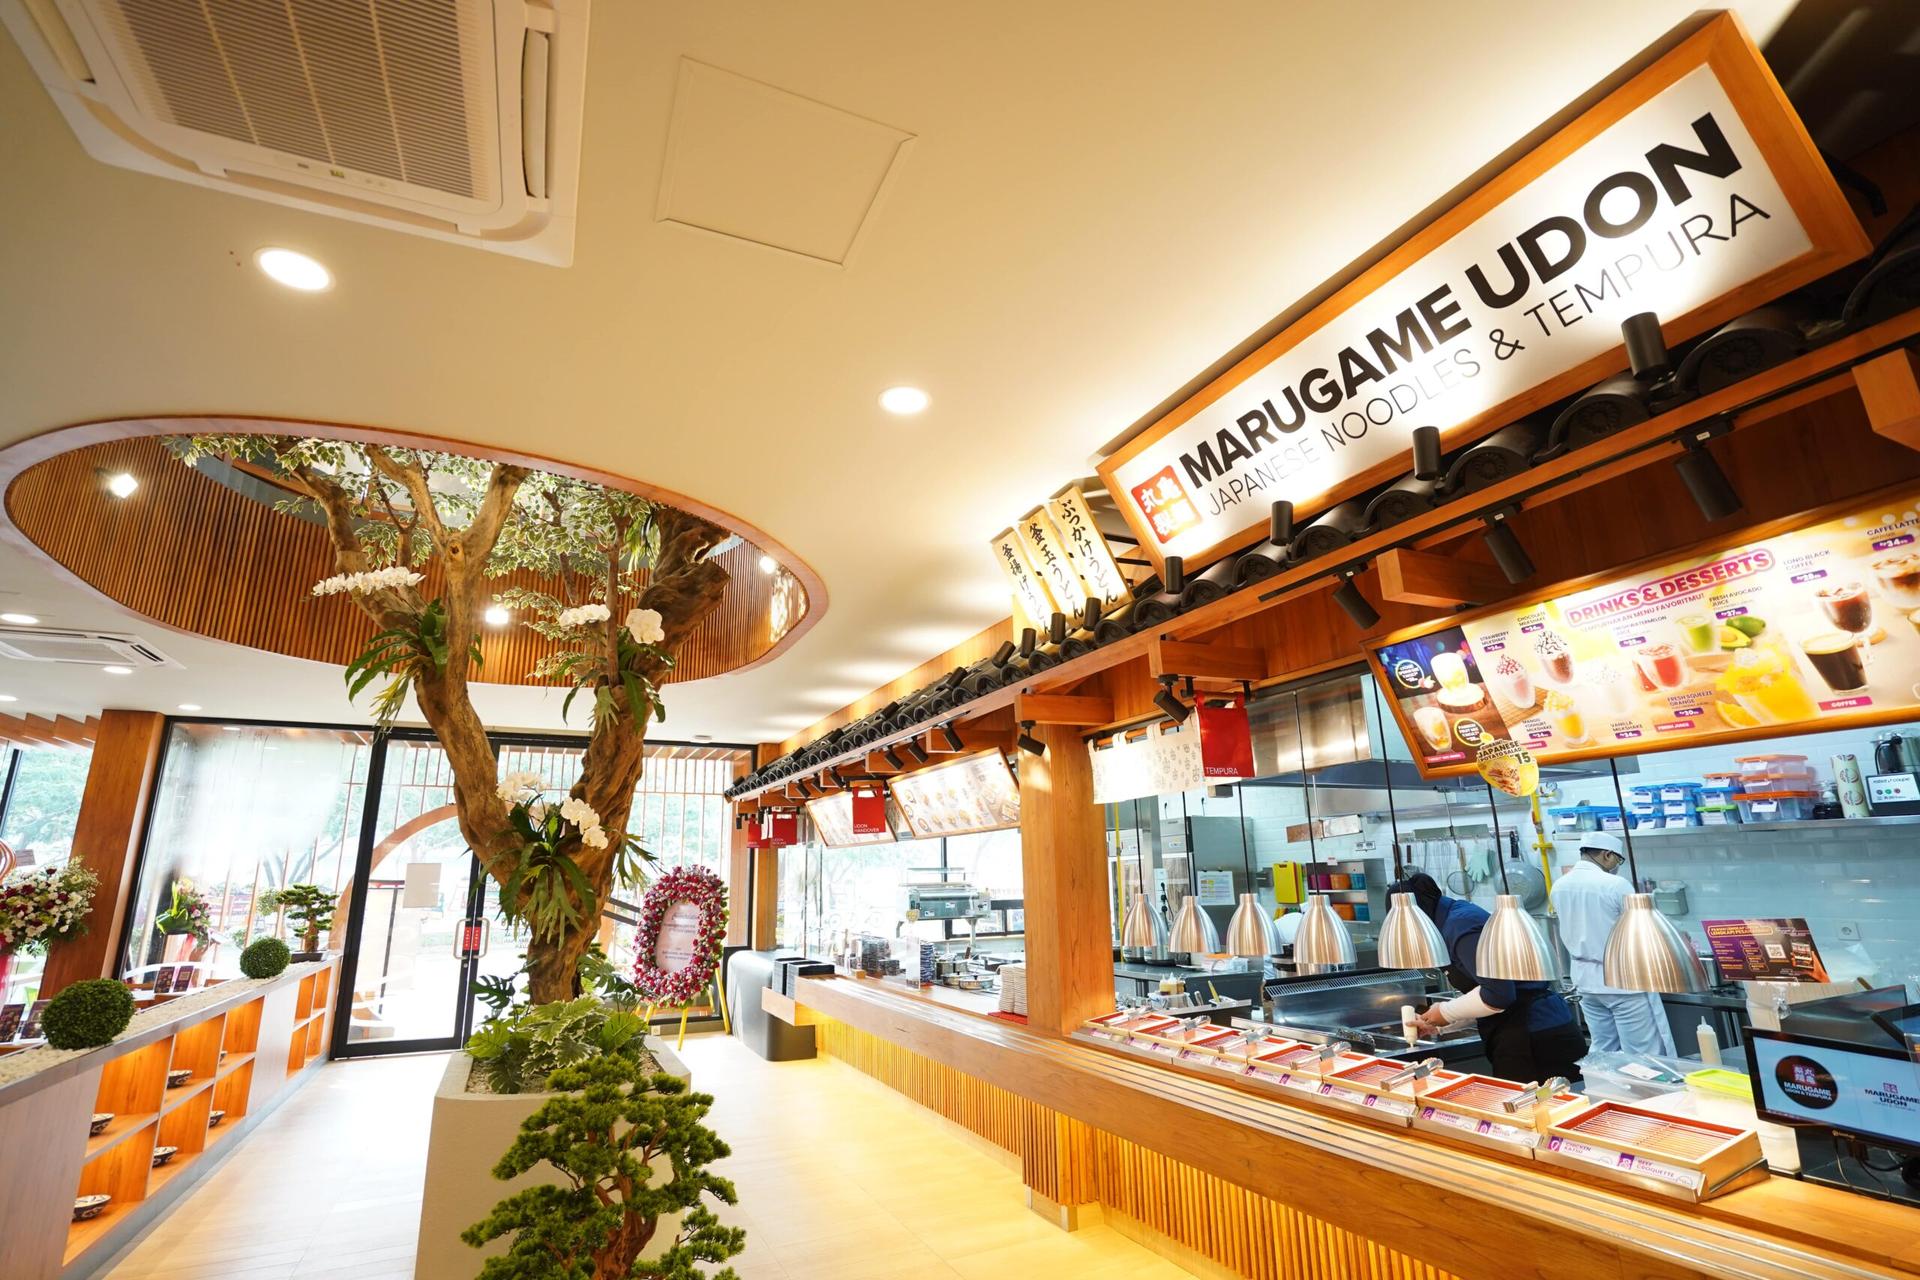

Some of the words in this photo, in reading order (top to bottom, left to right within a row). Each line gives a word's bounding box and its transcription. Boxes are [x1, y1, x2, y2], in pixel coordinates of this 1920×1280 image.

[1179, 284, 1472, 489] MARUGAME
[1464, 112, 1742, 309] UDON
[1209, 437, 1320, 511] JAPANESE
[1320, 348, 1481, 452] NOODLES
[1488, 328, 1526, 360] &
[1523, 193, 1771, 337] TEMPURA
[1866, 524, 1892, 536] CAFFE
[1569, 592, 1641, 625] DRINKS
[1642, 587, 1659, 602] &
[1659, 552, 1772, 598] DESSERTS
[1729, 586, 1763, 598] AVOCADO
[1634, 607, 1655, 618] MENU
[1656, 592, 1706, 611] FAVORITMU!
[1479, 740, 1520, 758] JAPANESE
[1480, 751, 1502, 762] POTATO
[1205, 766, 1239, 776] TEMPURA
[1783, 1081, 1832, 1095] MARUGAME
[1864, 1088, 1920, 1105] MARUGAME
[1879, 1097, 1908, 1108] UDON
